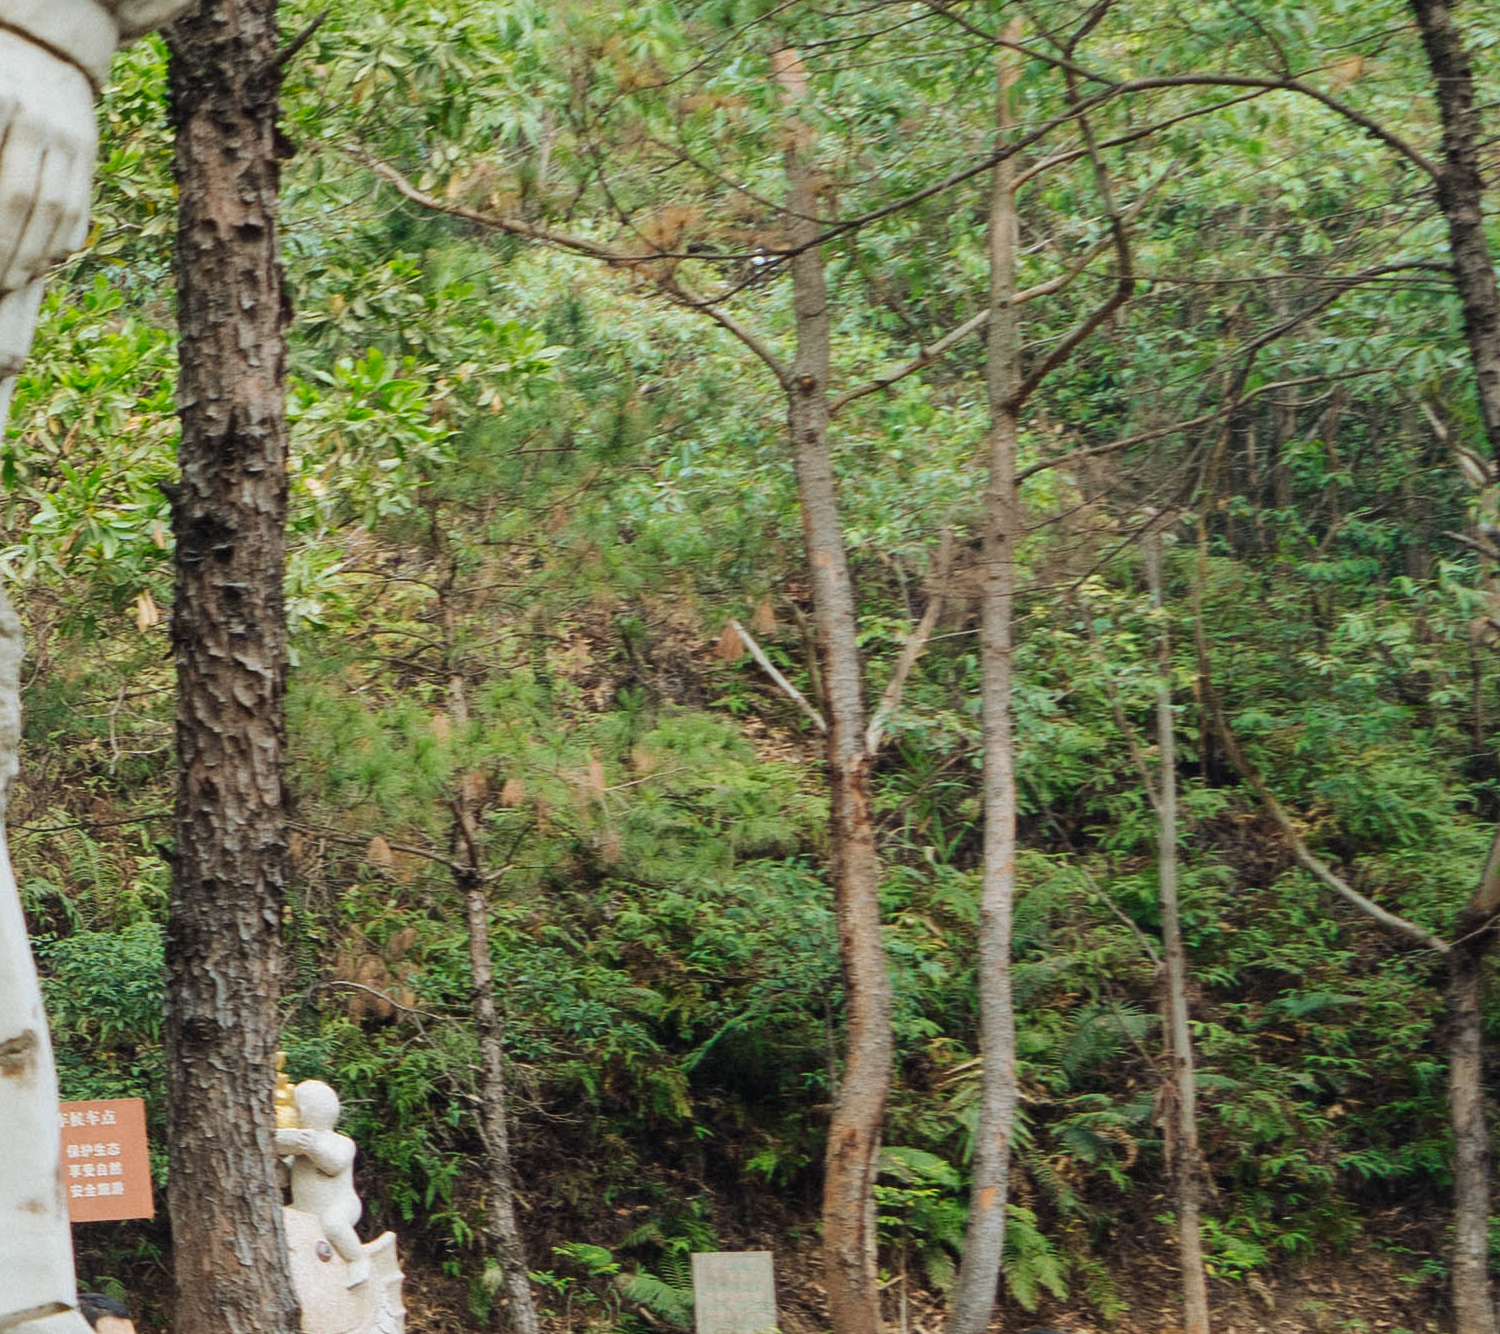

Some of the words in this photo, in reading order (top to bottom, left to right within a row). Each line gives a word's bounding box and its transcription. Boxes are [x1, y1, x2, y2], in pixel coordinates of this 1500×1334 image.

[67, 1143, 120, 1158] 保护生态
[68, 1162, 123, 1177] 享受自然
[70, 1182, 124, 1198] 安全旅游
